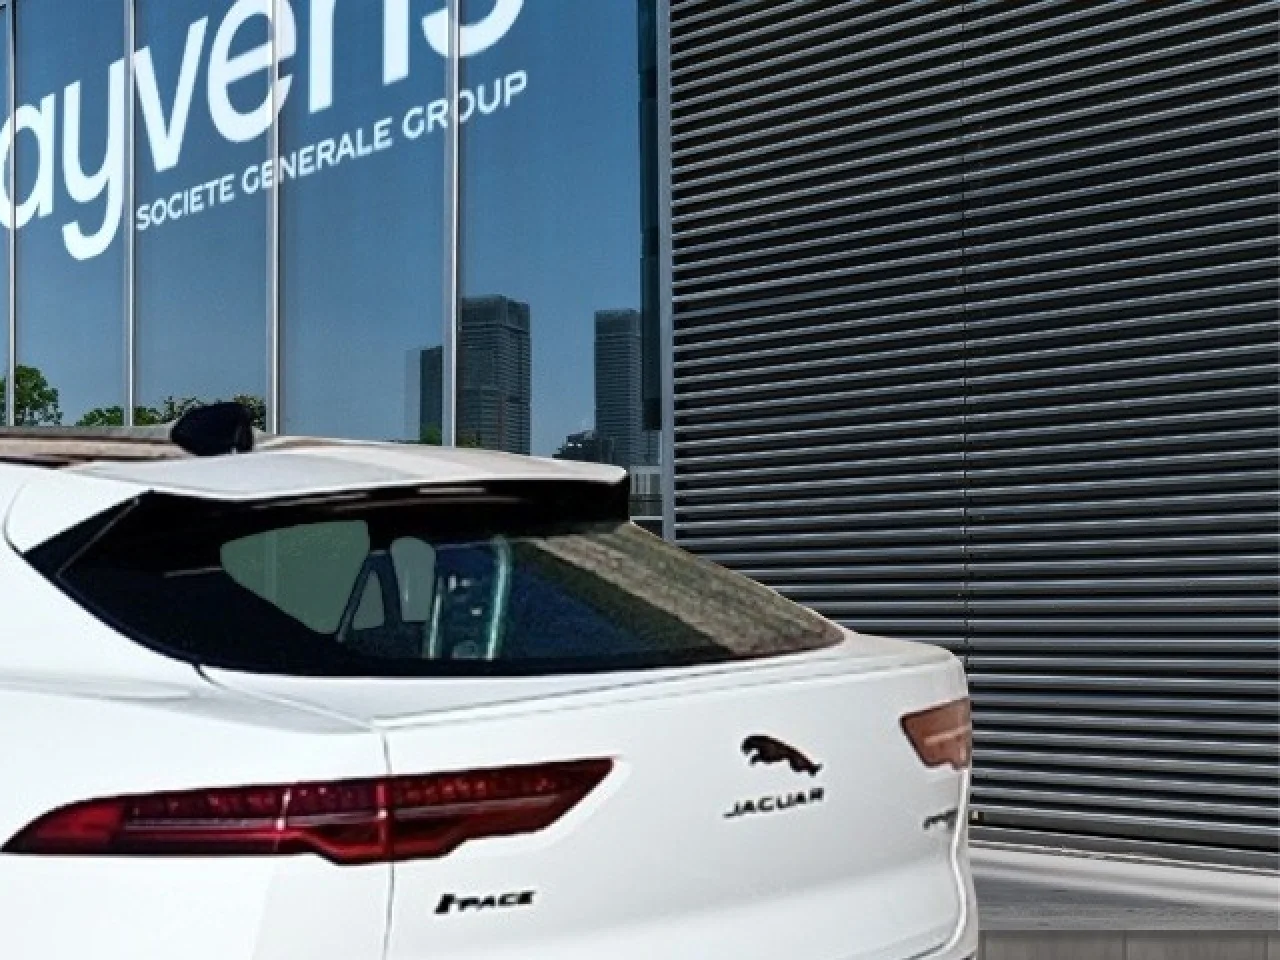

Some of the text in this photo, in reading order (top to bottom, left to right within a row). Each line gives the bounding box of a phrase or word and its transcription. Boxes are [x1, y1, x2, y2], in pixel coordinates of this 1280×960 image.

[135, 69, 528, 231] SOCIETE GENERALE GROUP
[723, 787, 824, 818] JAGUAR
